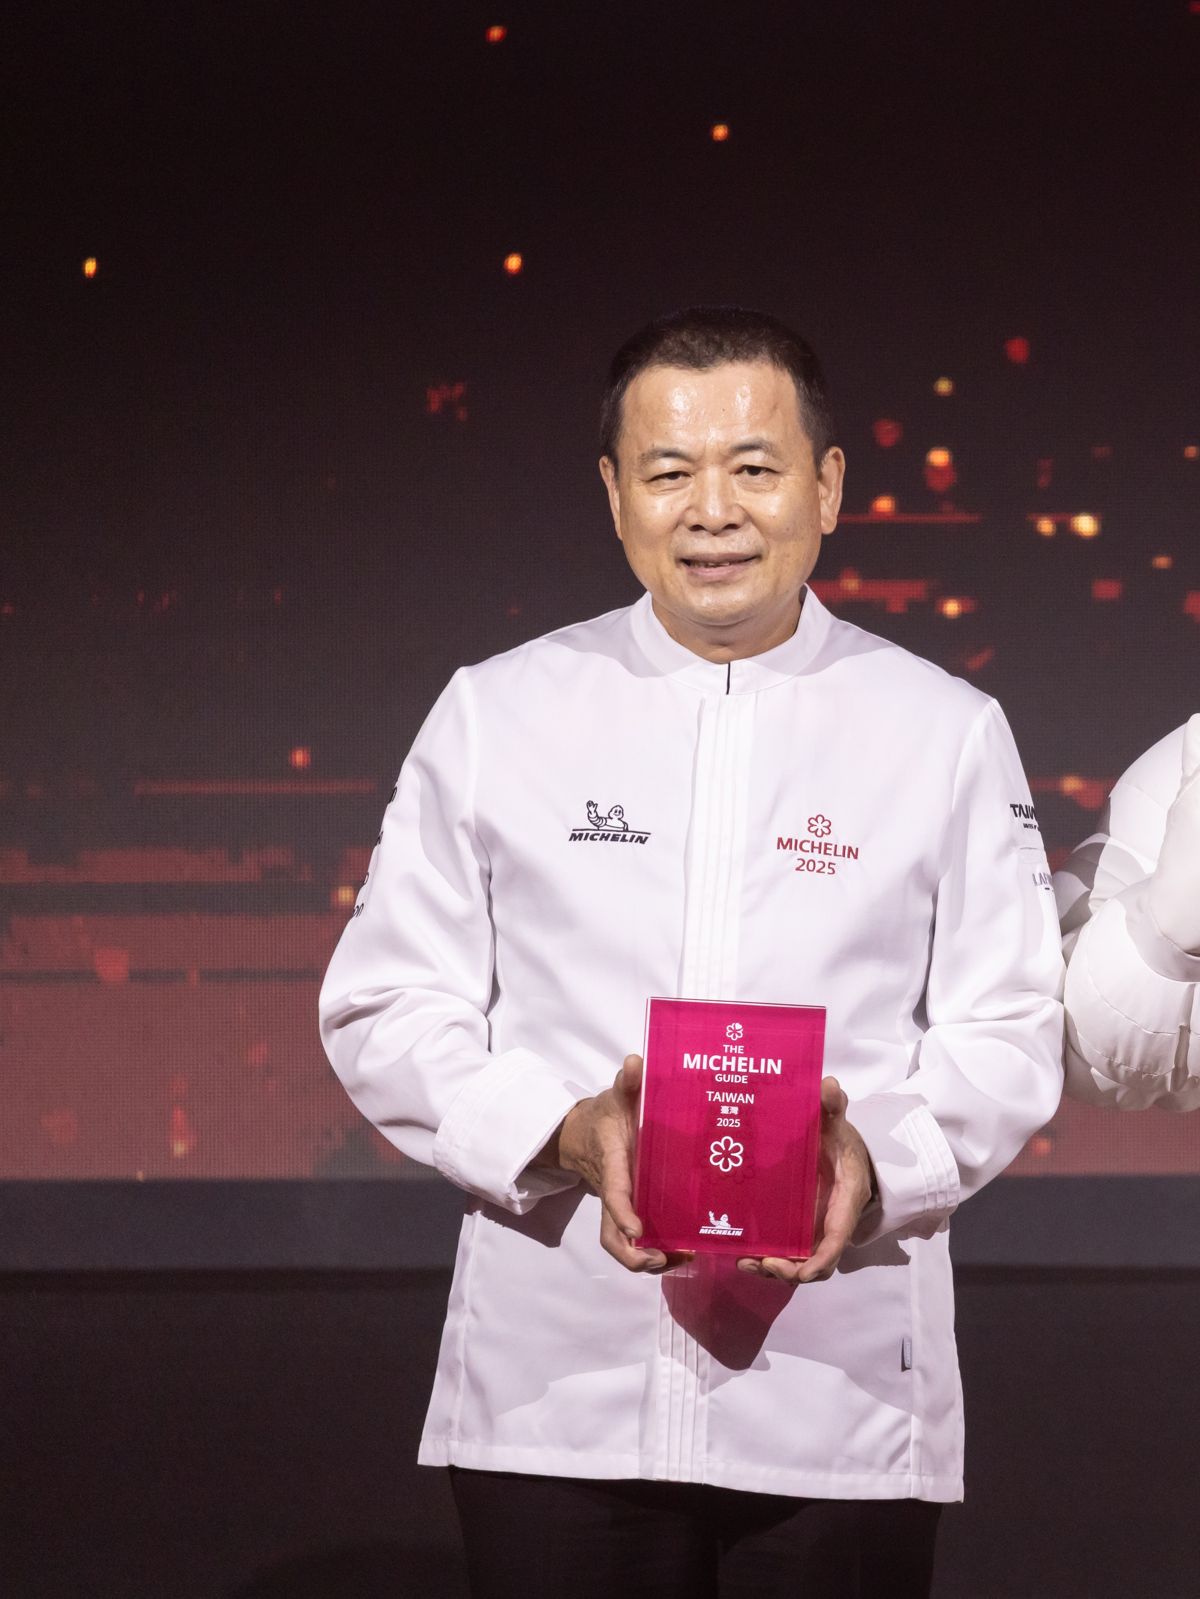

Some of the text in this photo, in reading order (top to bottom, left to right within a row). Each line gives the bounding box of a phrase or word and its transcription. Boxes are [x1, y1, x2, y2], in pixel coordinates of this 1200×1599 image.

[568, 831, 651, 846] MICHELIN
[776, 836, 860, 860] MICHELIN
[794, 857, 837, 876] 2025
[723, 1044, 745, 1055] THE
[682, 1053, 782, 1075] MICHELIN
[714, 1073, 749, 1084] GUIDE
[706, 1090, 755, 1105] TAIWAN
[716, 1117, 741, 1128] 2025
[698, 1227, 744, 1237] MICHELIN
